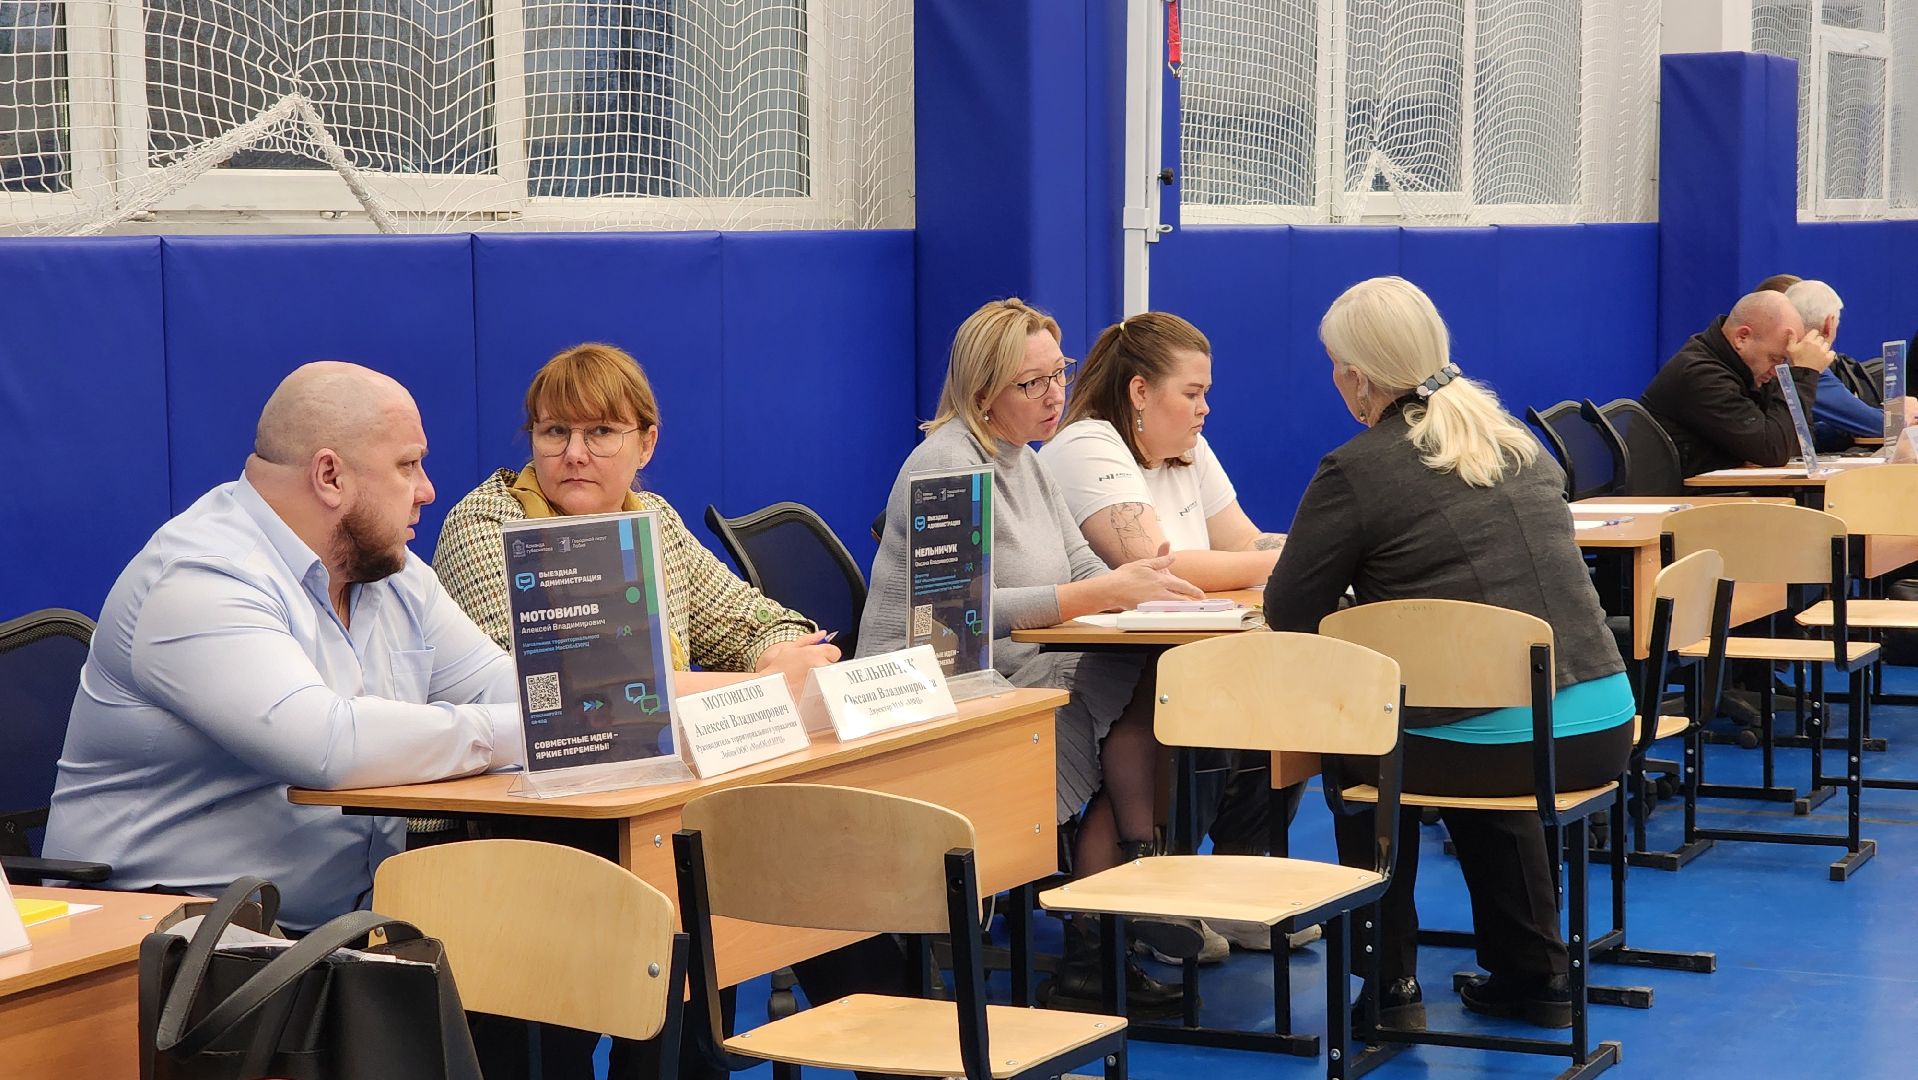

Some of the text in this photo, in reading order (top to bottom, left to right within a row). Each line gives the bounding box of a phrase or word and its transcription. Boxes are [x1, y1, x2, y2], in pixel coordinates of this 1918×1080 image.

[915, 544, 957, 557] МЕЛЬНИЧУК
[539, 568, 577, 578] ВЫЕЗДНАЯ
[540, 575, 601, 587] АДМИНИСТРАЦИЯ
[520, 604, 599, 623] МОТОВИЛОВ
[522, 619, 606, 634] Алексей Владимирович
[845, 658, 916, 684] МЕЛЬНИЧК
[701, 685, 764, 711] МОТОВИЛОВ
[877, 679, 936, 699] Владимироа
[695, 704, 789, 737] Алексей Владимирович
[535, 736, 589, 750] СОВМЕСТНЫЕ
[590, 732, 612, 742] ИДЕИ
[536, 743, 609, 760] ЯРКИЕ ПЕРЕМЕНЫ!
